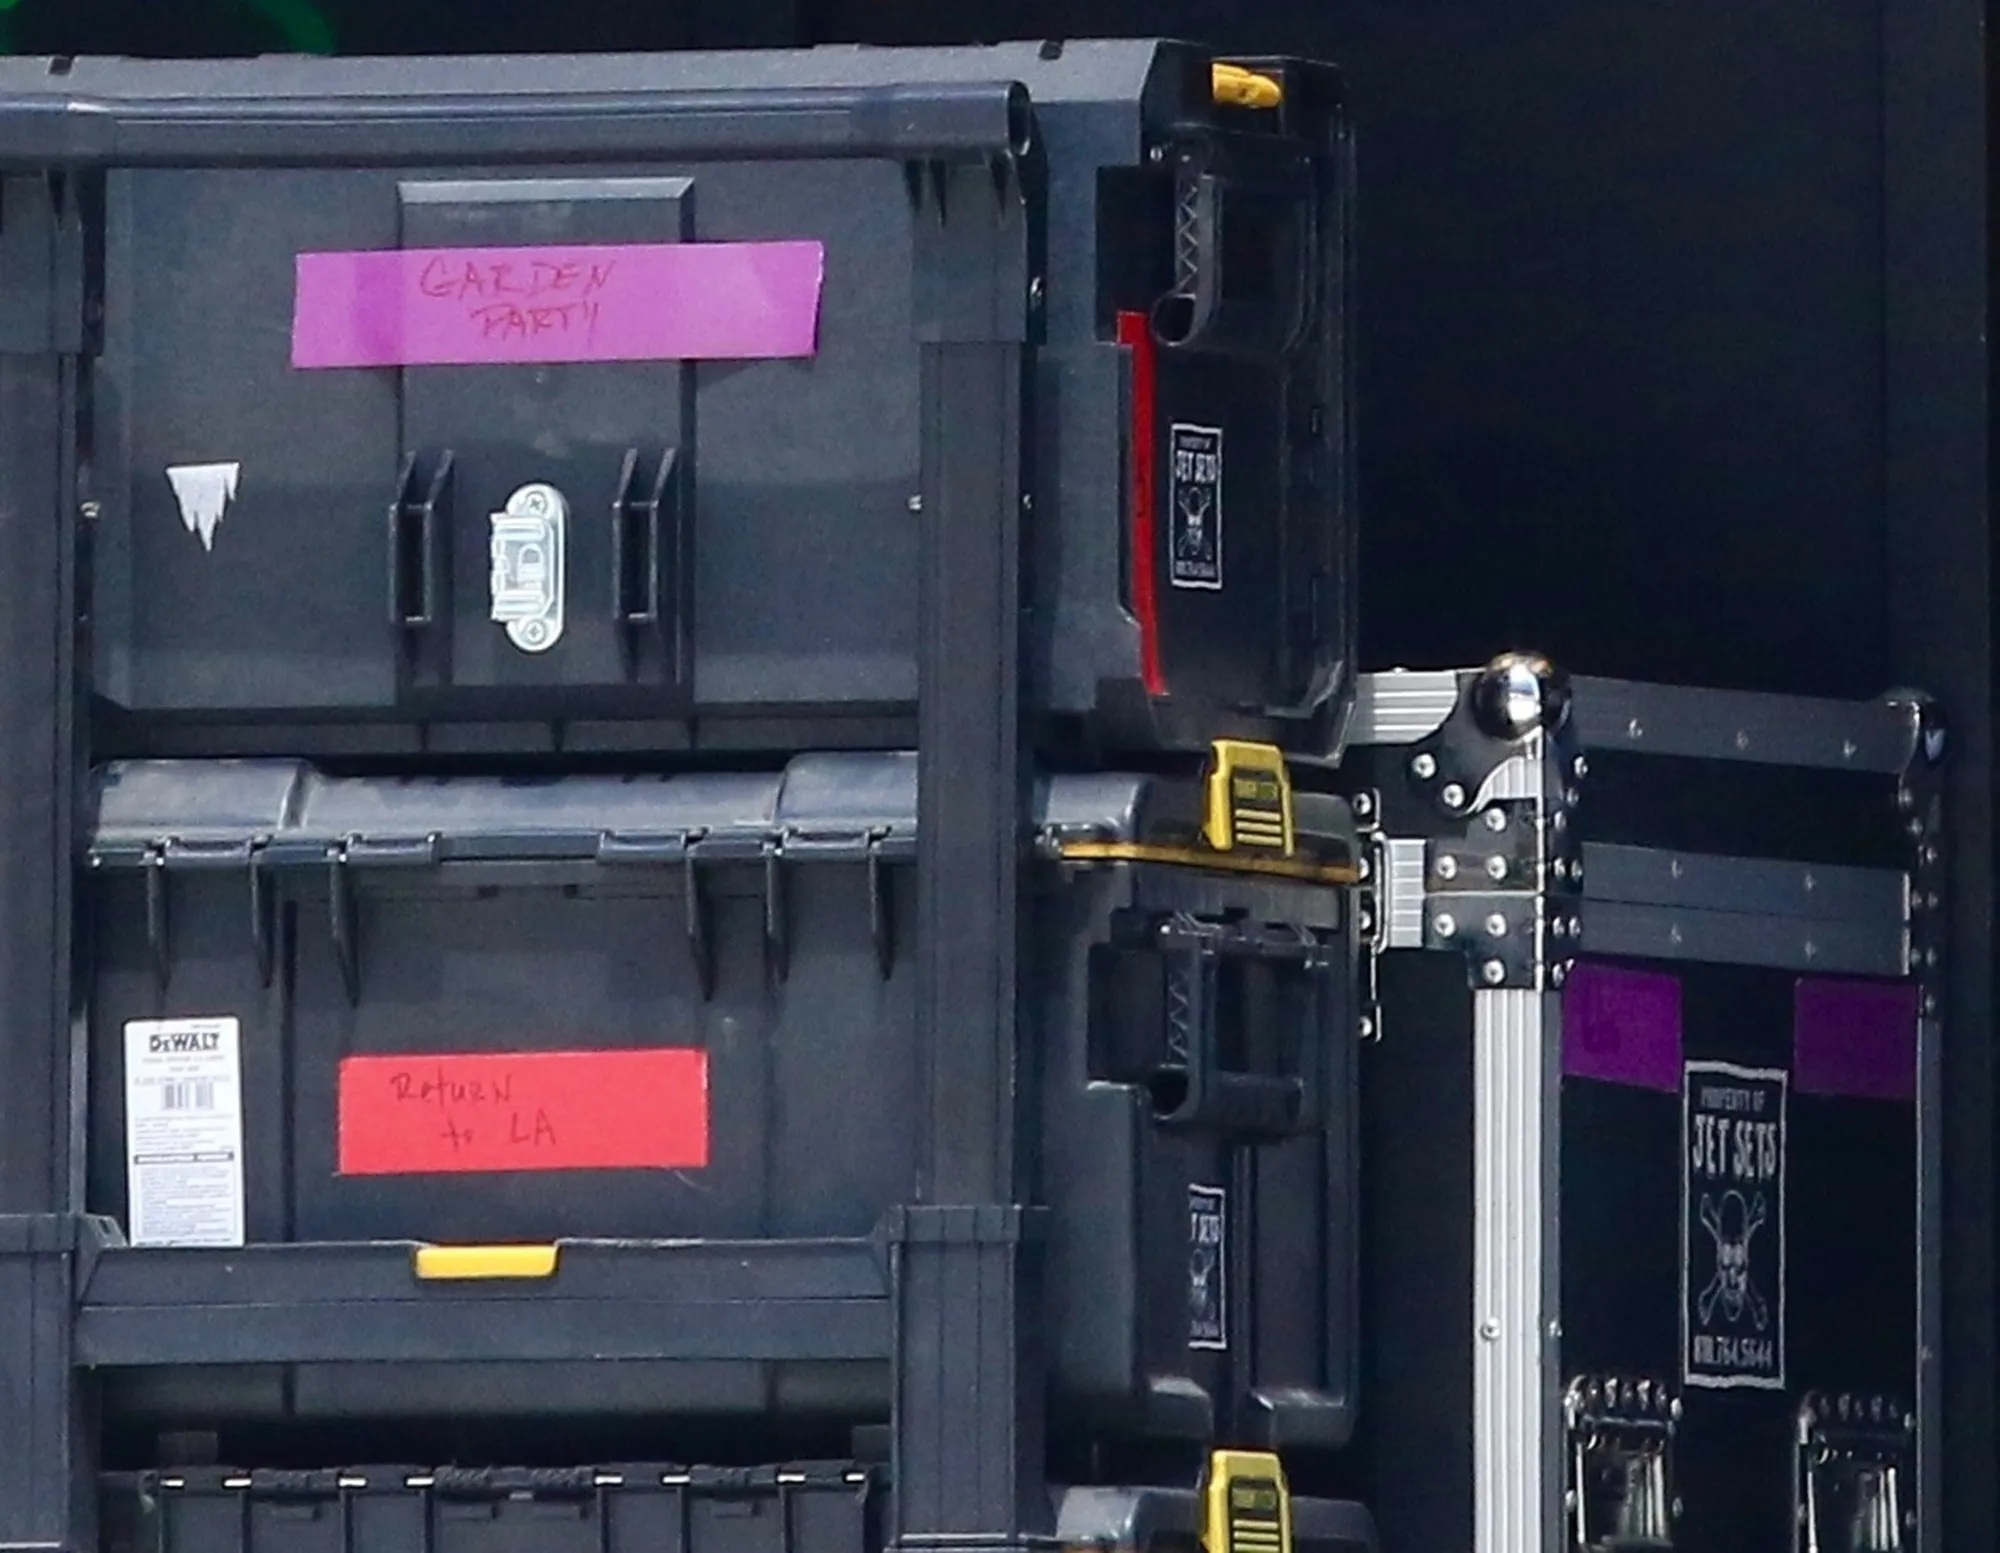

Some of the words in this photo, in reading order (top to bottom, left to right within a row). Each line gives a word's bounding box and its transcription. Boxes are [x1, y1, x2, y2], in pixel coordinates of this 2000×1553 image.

[420, 255, 616, 301] GARDEN
[470, 299, 598, 349] PARTY
[511, 1108, 556, 1146] LA
[1692, 1114, 1730, 1178] JET
[1733, 1119, 1777, 1181] SETS
